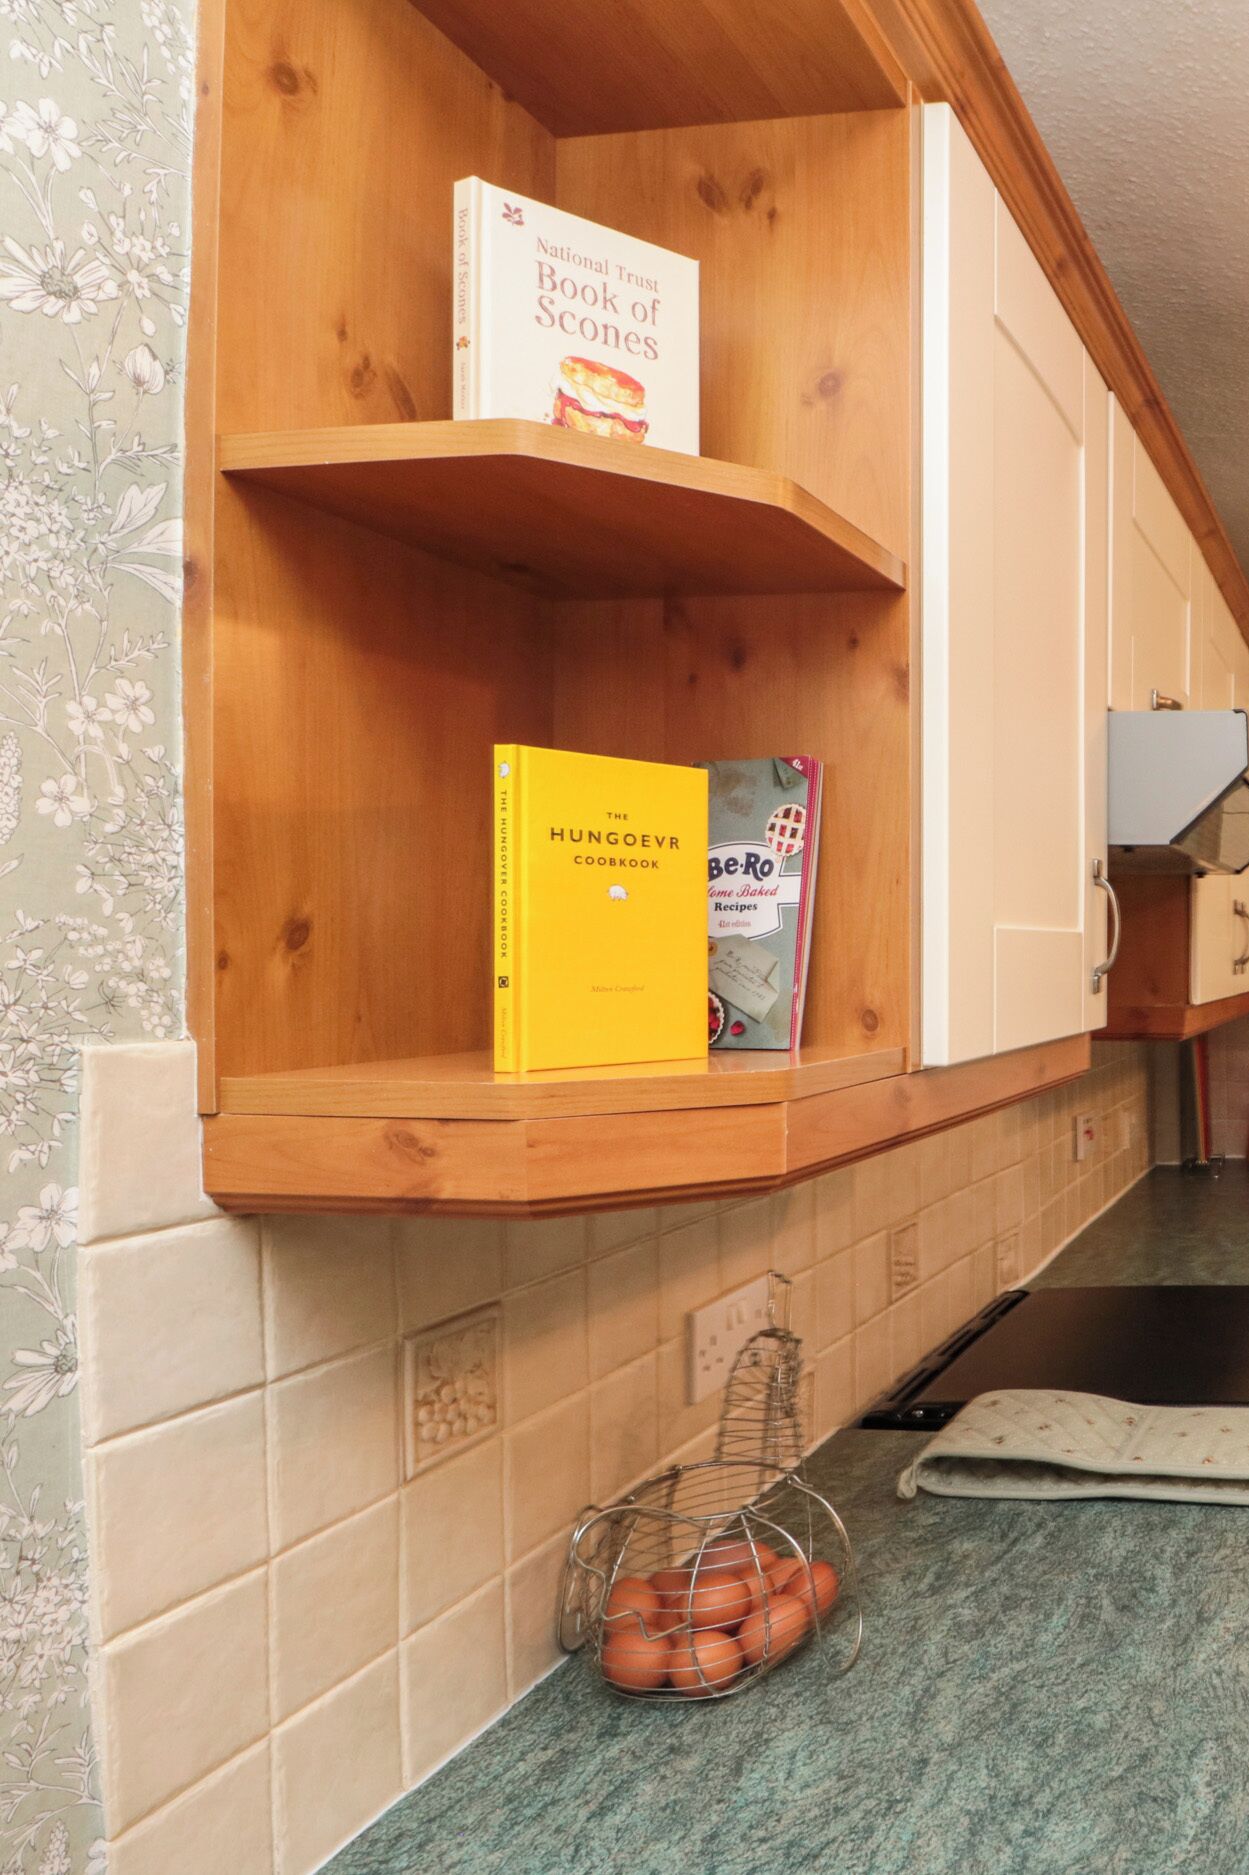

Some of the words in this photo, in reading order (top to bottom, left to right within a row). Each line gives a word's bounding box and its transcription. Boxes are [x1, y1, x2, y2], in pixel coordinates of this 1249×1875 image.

[458, 207, 469, 249] Book
[458, 252, 470, 268] of
[536, 236, 610, 276] National
[615, 264, 660, 294] Trust
[458, 270, 469, 325] Scones
[535, 260, 620, 315] Book
[631, 298, 661, 326] of
[535, 295, 660, 361] Scones
[606, 811, 629, 821] THE
[550, 827, 680, 850] HUNGOEVR
[736, 884, 780, 898] Baked
[714, 902, 758, 913] Recipes
